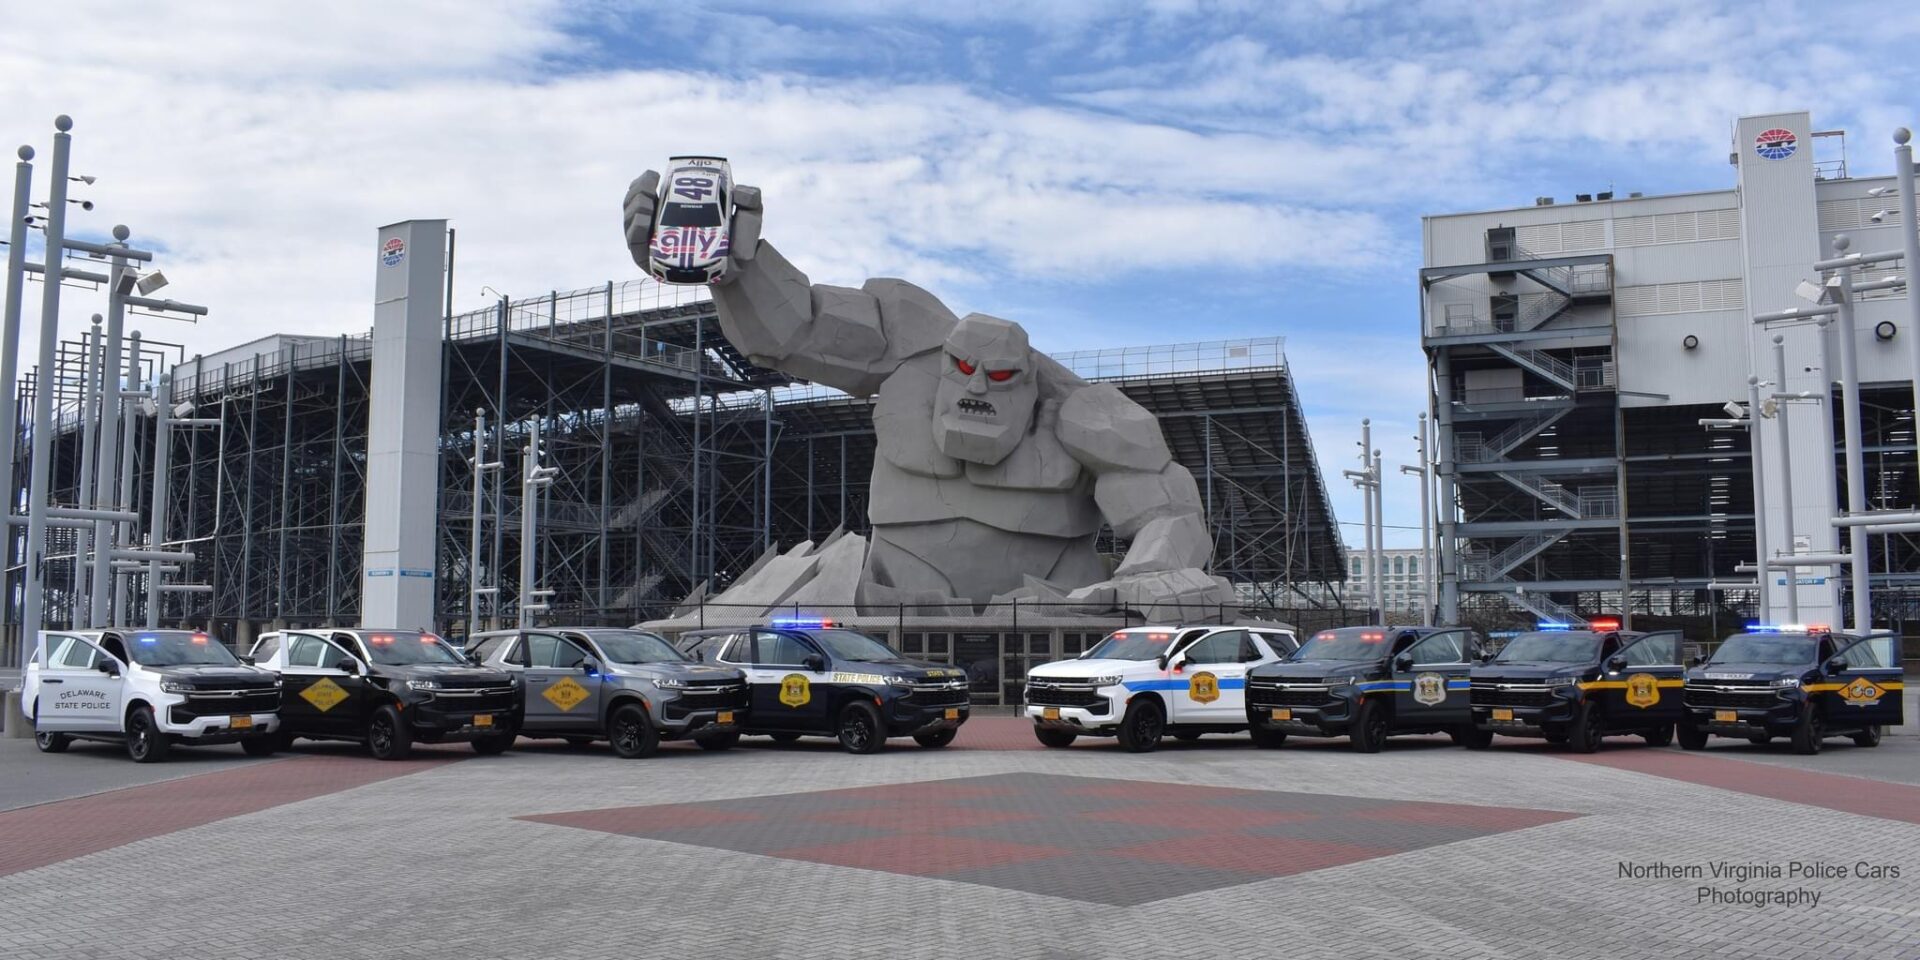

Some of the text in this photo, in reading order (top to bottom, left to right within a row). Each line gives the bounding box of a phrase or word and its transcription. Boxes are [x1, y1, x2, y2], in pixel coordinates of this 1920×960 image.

[674, 178, 713, 201] 48
[661, 227, 717, 265] ally
[833, 673, 882, 684] STATE POLICE
[60, 689, 107, 700] DELAWARE
[1847, 686, 1876, 698] 100
